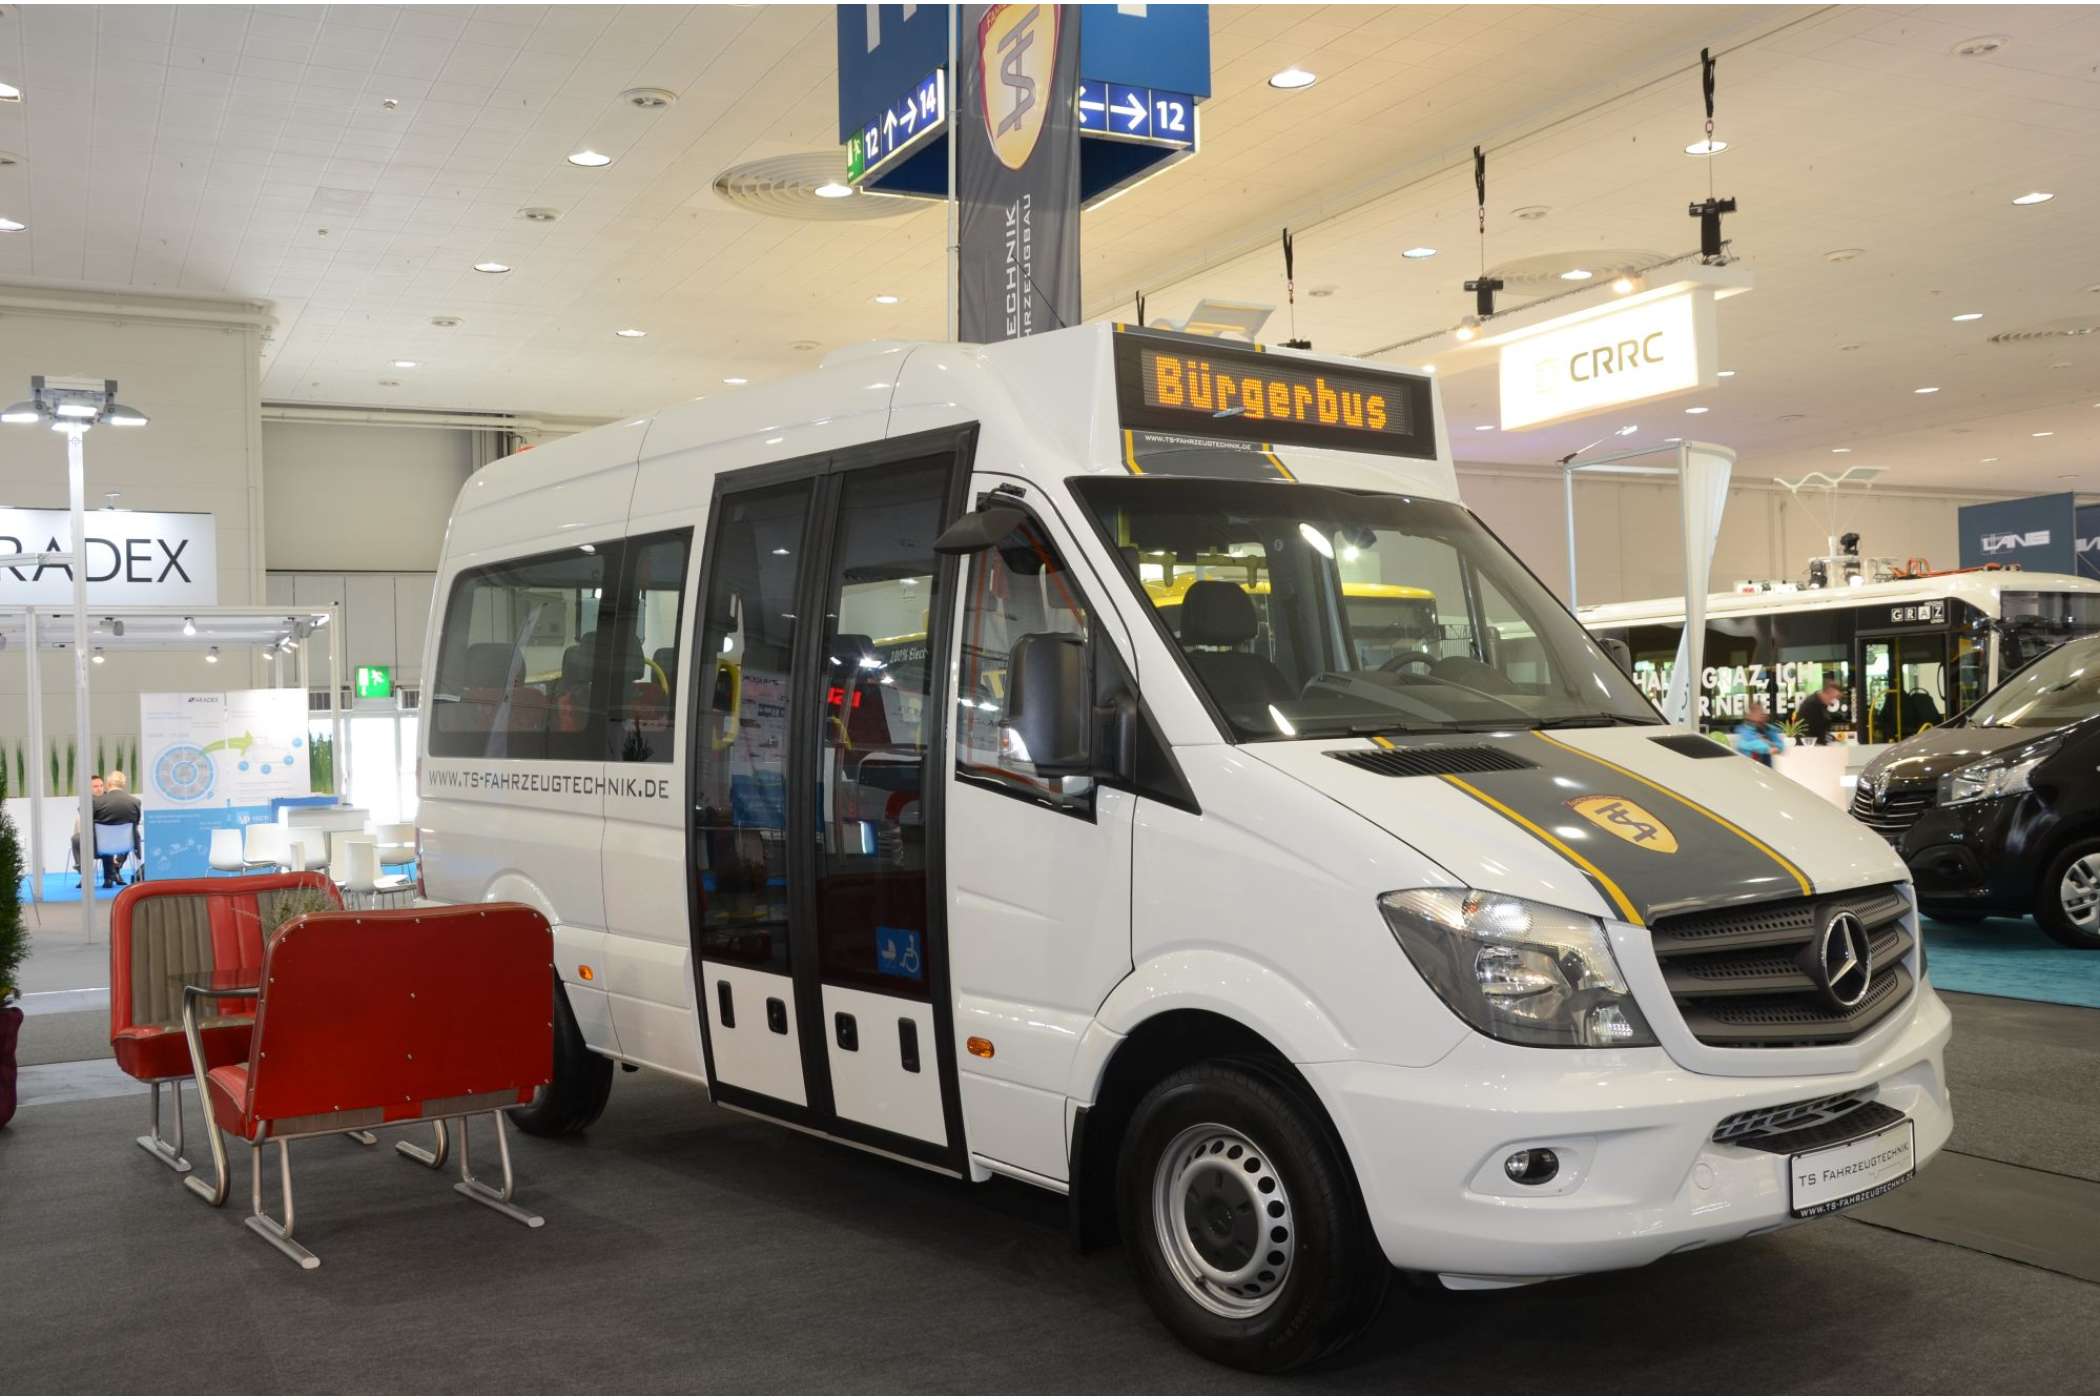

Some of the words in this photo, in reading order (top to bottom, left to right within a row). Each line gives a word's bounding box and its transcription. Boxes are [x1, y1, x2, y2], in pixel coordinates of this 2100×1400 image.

[865, 127, 880, 159] 12
[920, 83, 936, 119] 14
[1156, 101, 1185, 132] 12
[1570, 331, 1664, 382] CRRC
[1155, 354, 1388, 430] Bürgerbus
[1892, 604, 1945, 622] GRAZ
[1702, 663, 1770, 690] GRAZ,
[1776, 661, 1814, 686] ICH
[428, 769, 670, 799] WWW.TS-FAHRZEUGTECHNIK.DE
[1799, 1173, 1817, 1188] TS
[1822, 1142, 1910, 1183] FAHRZEUGTECHNIK
